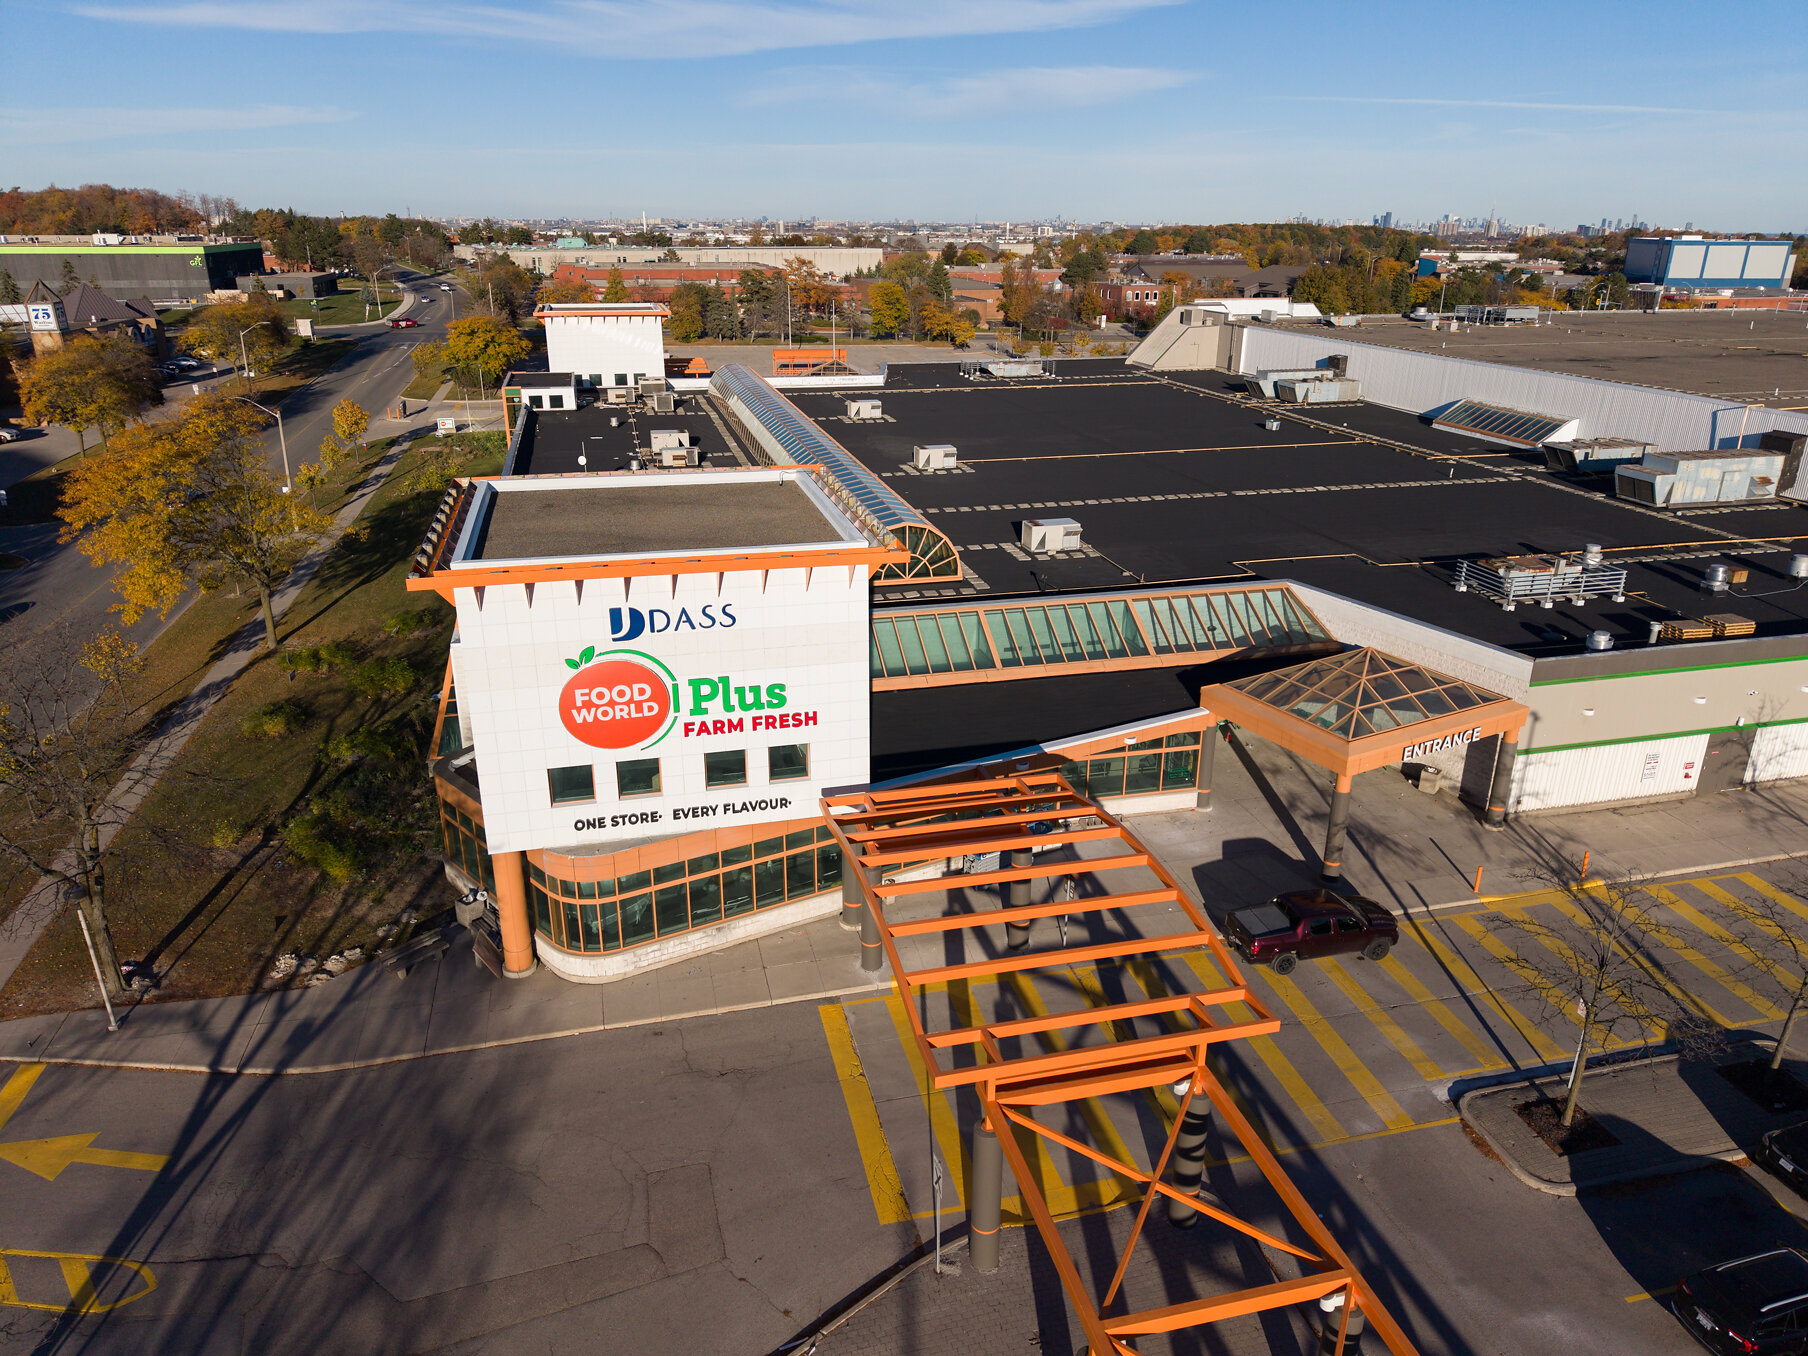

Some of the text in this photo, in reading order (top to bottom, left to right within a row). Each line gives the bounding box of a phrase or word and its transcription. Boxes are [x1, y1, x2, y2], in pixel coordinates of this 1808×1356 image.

[32, 308, 51, 320] 75
[648, 603, 737, 633] DASS
[574, 683, 652, 707] FOOD
[688, 675, 788, 716] Plus
[571, 701, 659, 723] WORLD
[683, 711, 817, 737] FARM FRESH
[1402, 727, 1482, 762] ENTRANCE
[574, 816, 607, 831] ONE
[672, 804, 719, 820] EVERY
